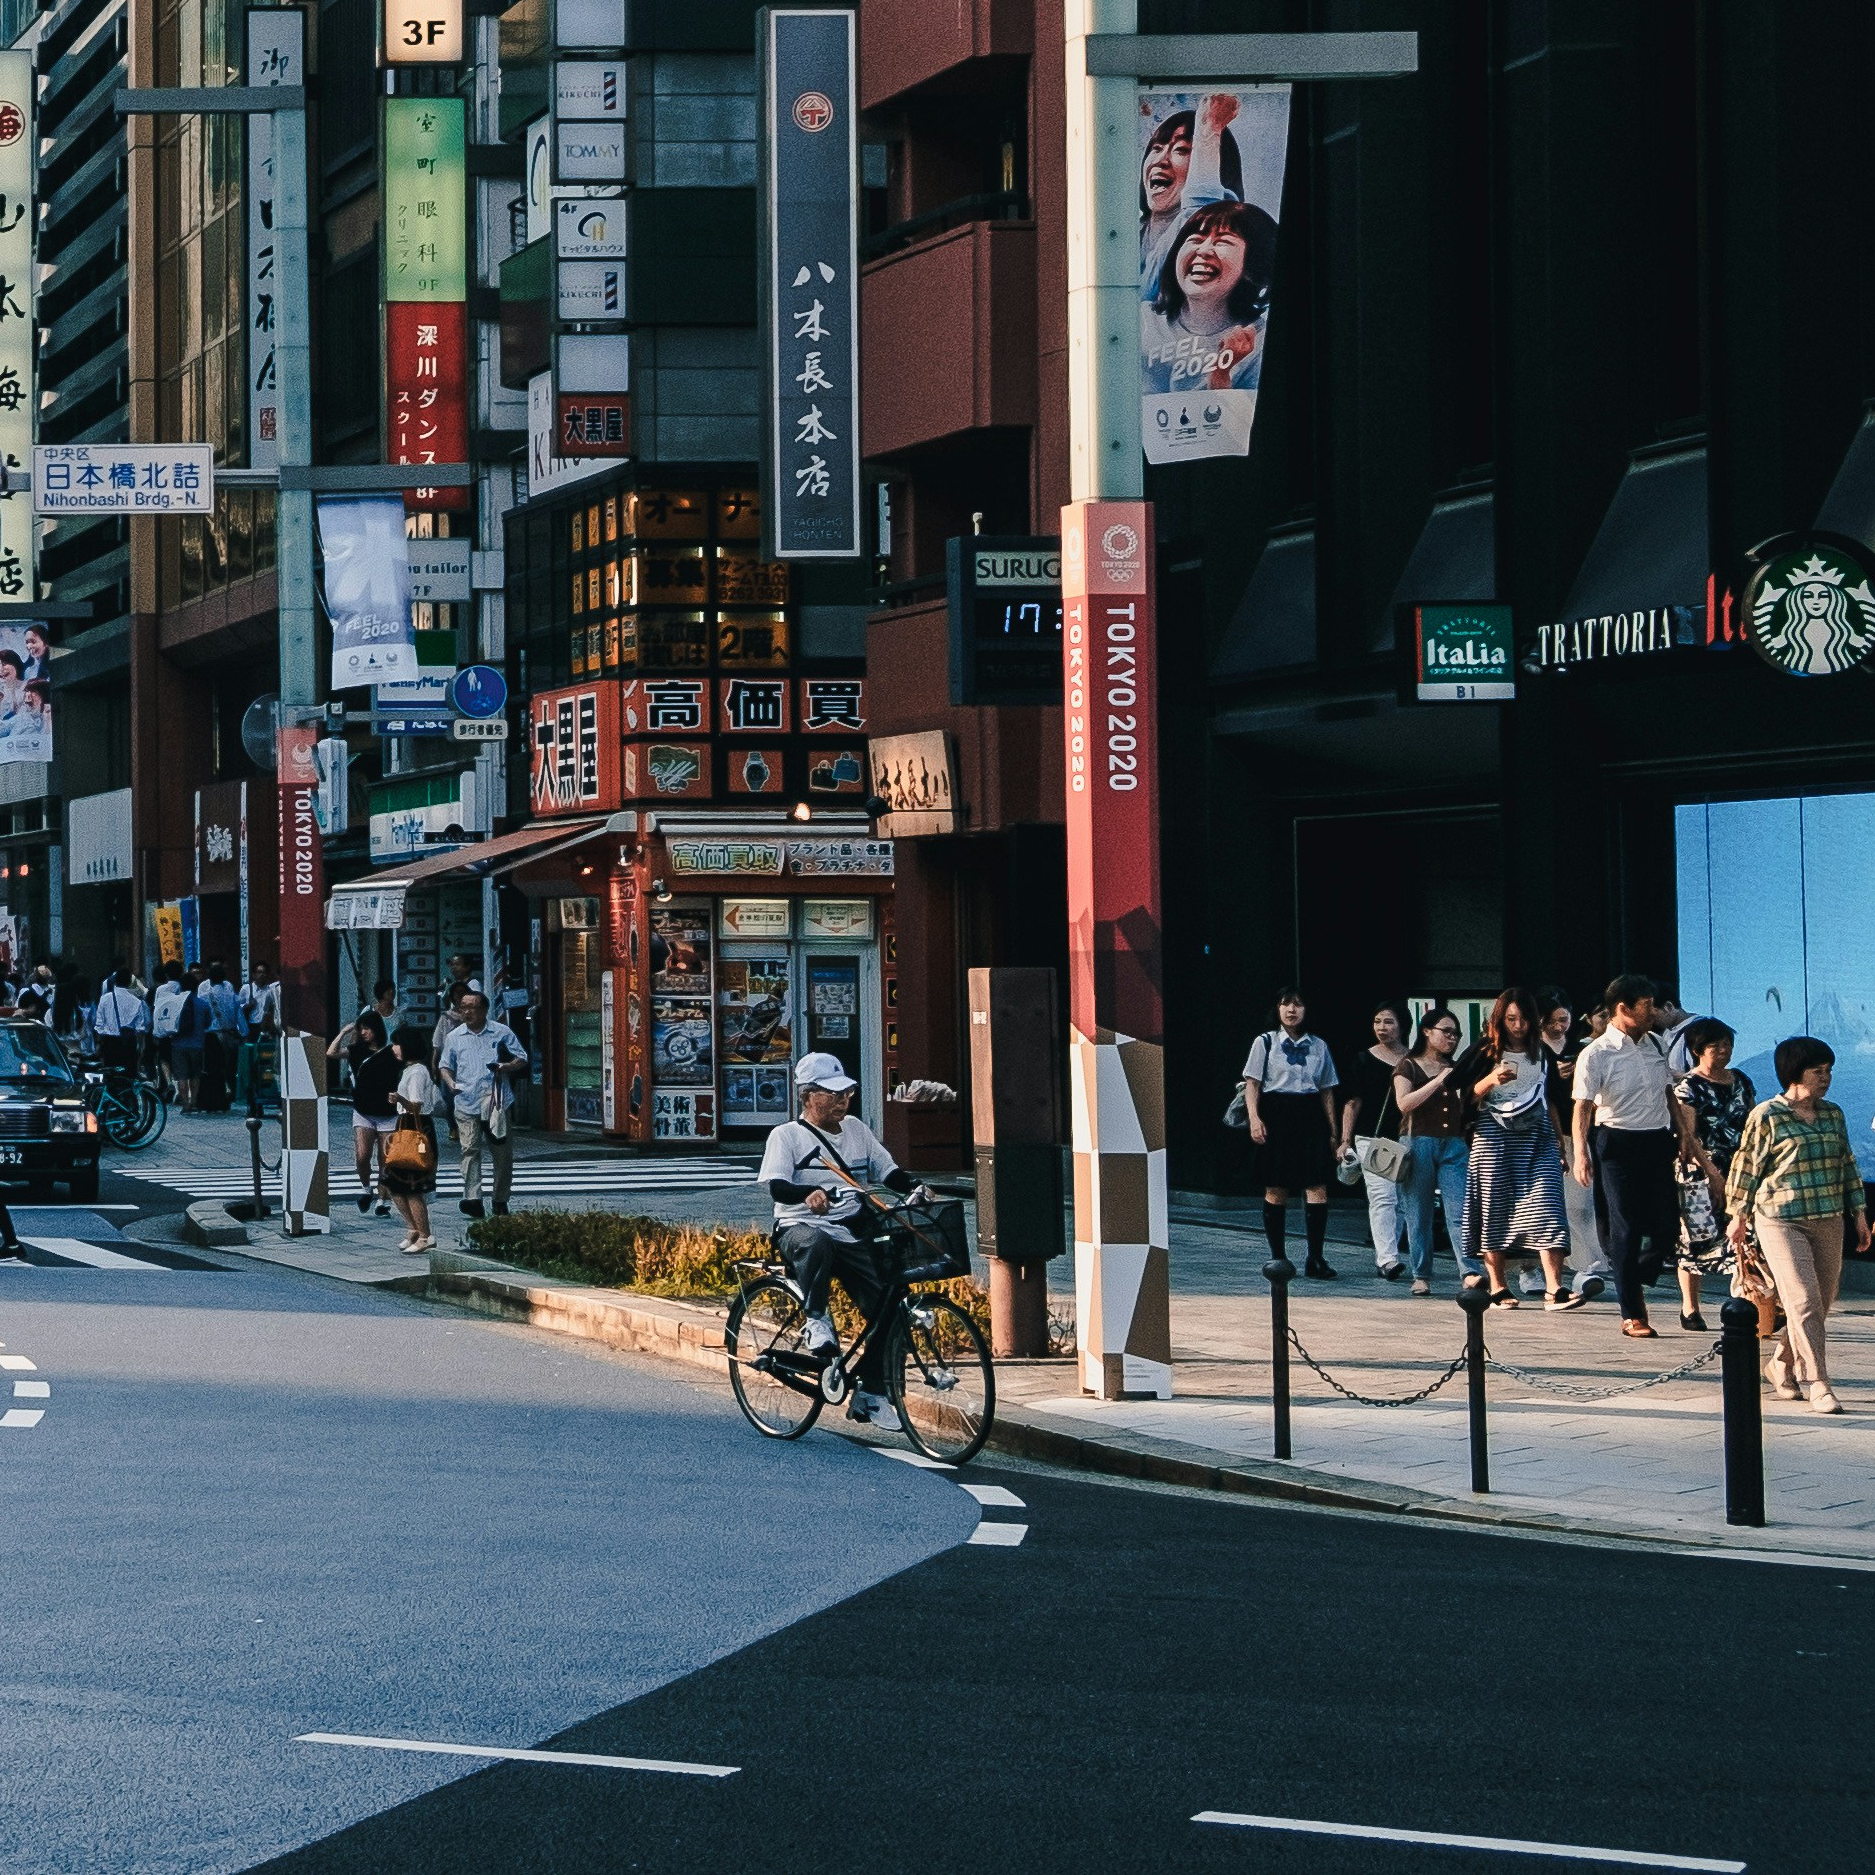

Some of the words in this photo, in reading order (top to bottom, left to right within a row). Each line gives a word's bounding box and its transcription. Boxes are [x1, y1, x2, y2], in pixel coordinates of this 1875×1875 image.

[402, 20, 446, 46] 3F
[564, 143, 620, 159] TOMMY
[416, 114, 439, 264] 室町眼科
[560, 203, 578, 215] 4F
[1146, 333, 1208, 368] FEEL
[1171, 349, 1235, 382] 2020
[791, 261, 837, 499] 八木長本店
[563, 406, 623, 445] 大黒屋
[43, 447, 90, 461] 中央区
[46, 462, 200, 490] 日本橋北詰
[43, 491, 129, 507] Nihonbashi
[425, 563, 468, 574] tailor
[361, 621, 400, 640] 2020
[1538, 607, 1672, 666] TRATTORIA
[1068, 604, 1082, 708] TOKYO
[1106, 603, 1136, 707] TOKYO
[1456, 686, 1476, 699] B1
[535, 691, 600, 811] 大黒屋
[1070, 721, 1085, 792] 2020
[1108, 714, 1138, 792] 2020
[294, 787, 311, 847] TOKYO
[296, 850, 314, 895] 2020
[673, 842, 778, 871] 高価買取
[654, 1095, 691, 1116] 美術
[654, 1117, 691, 1137] 骨董
